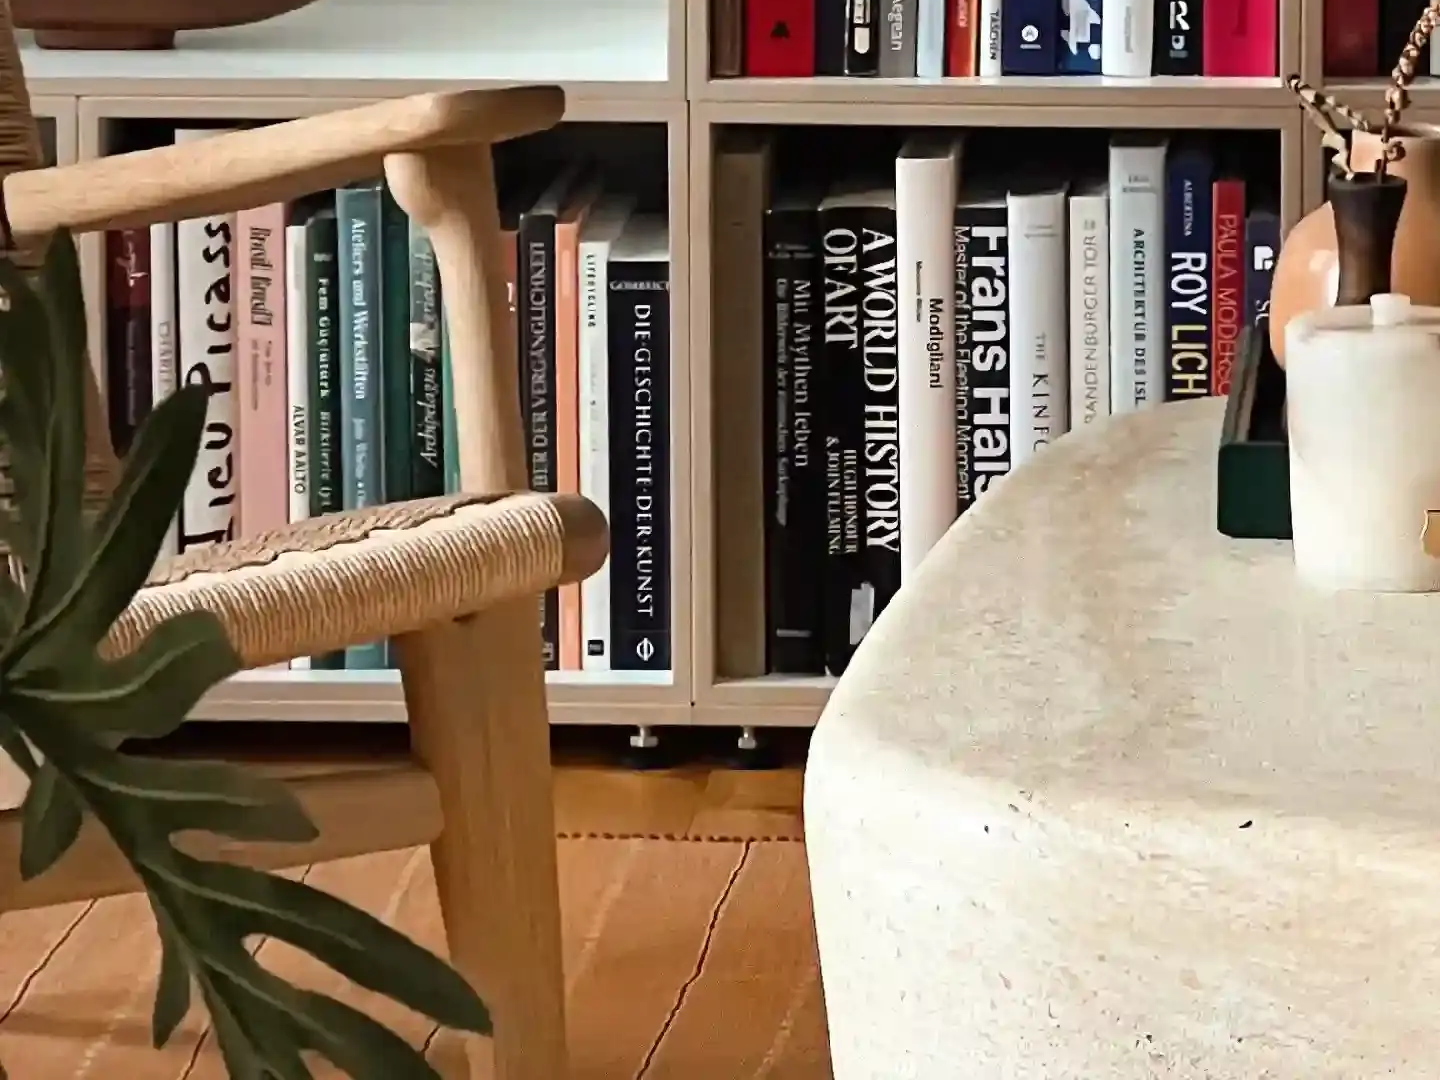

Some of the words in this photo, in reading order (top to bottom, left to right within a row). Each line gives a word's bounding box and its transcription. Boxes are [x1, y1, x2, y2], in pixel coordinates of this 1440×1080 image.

[350, 218, 368, 277] Ateliers
[823, 227, 858, 273] OF
[862, 227, 896, 255] A
[955, 225, 972, 285] Master
[1216, 213, 1239, 278] PAULA
[350, 280, 367, 307] und
[791, 279, 811, 313] Mit
[823, 277, 859, 351] ART
[957, 289, 972, 310] of
[971, 225, 1009, 372] Frans
[1132, 228, 1147, 342] ARCHITEKTUR
[1171, 251, 1208, 315] ROY
[633, 304, 652, 340] DIE
[862, 257, 898, 393] WORLD
[926, 297, 945, 389] Modigliani
[956, 313, 972, 344] the
[350, 310, 372, 400] Werkstätten
[787, 322, 812, 405] Mythen
[1133, 347, 1147, 376] DES
[1171, 323, 1209, 395] LICH
[632, 347, 653, 486] GESCHICHTE
[792, 411, 812, 468] leben
[293, 449, 306, 495] AALTO
[864, 403, 900, 553] HISTORY
[634, 494, 653, 538] DER
[635, 544, 654, 618] KUNST
